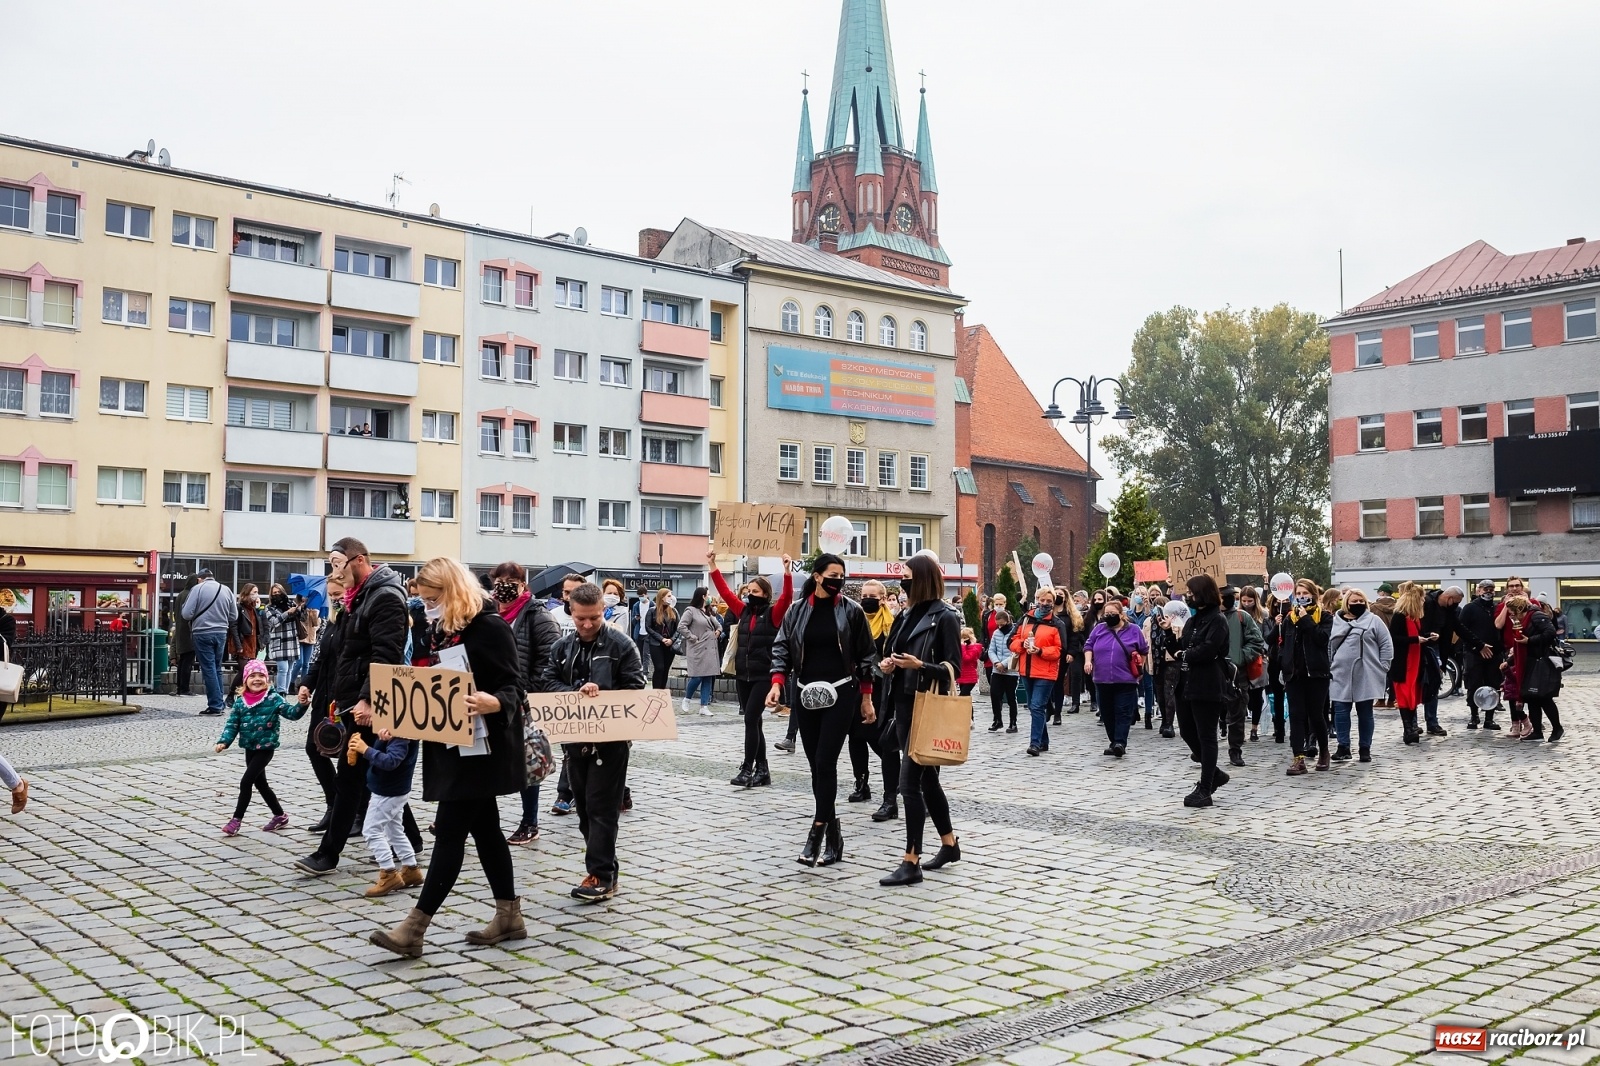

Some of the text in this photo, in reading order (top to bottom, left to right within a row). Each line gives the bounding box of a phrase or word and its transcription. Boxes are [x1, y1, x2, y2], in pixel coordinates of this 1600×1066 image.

[800, 371, 827, 381] Edukacja
[841, 363, 922, 380] SZKOŁY MEDYCZNE
[784, 383, 822, 394] NABÓR TRWA
[842, 388, 893, 401] TECHNIKUM
[841, 402, 888, 414] AKADEMIA
[895, 408, 923, 418] WIEKU
[1523, 486, 1577, 494] Telebimy-Raciborz.pl
[757, 511, 795, 536] MEGA
[721, 533, 781, 552] wkurzona
[1172, 540, 1216, 562] RZĄD
[1188, 559, 1201, 568] DO
[554, 693, 585, 706] STOP
[530, 704, 638, 722] OBOWIĄZEK
[544, 720, 606, 736] SZCZEPIEŃ
[933, 738, 962, 751] TASTA
